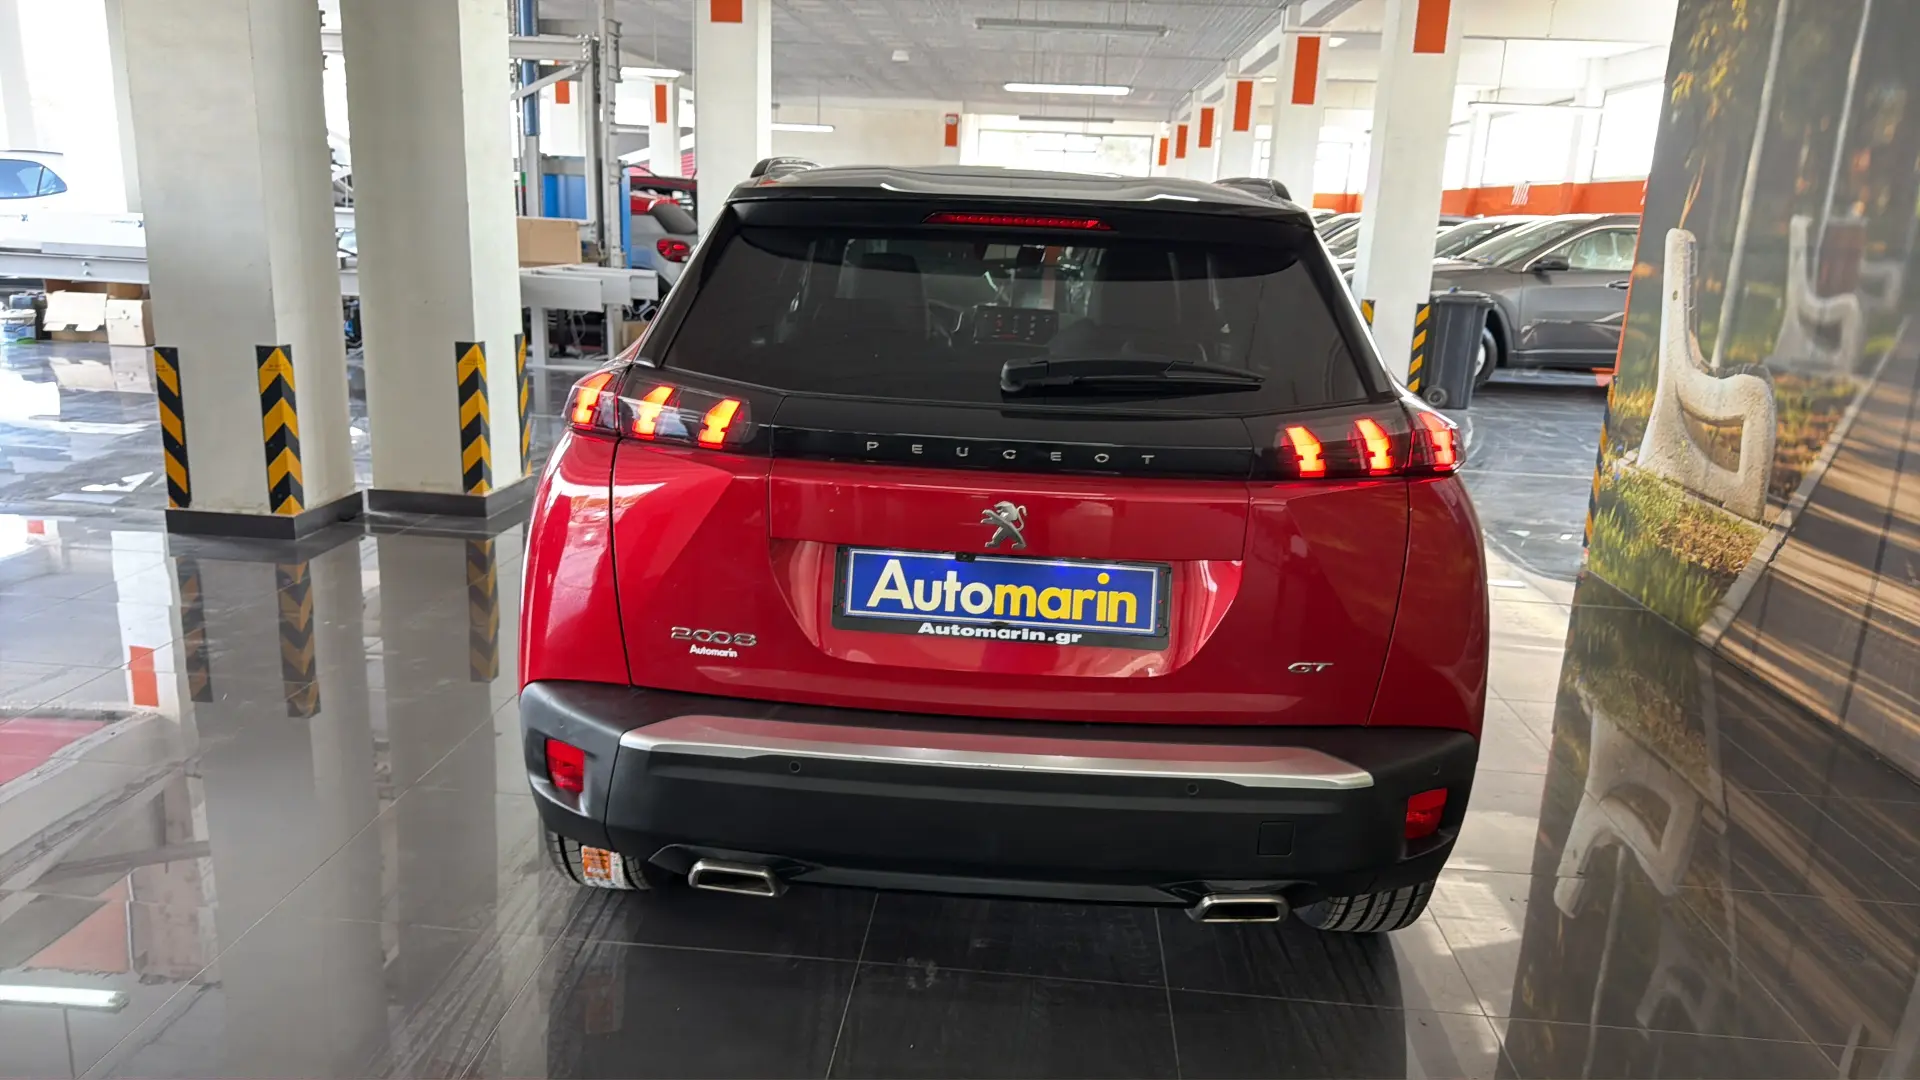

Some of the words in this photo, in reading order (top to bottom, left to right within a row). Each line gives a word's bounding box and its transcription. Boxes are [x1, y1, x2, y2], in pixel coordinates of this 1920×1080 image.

[866, 441, 1155, 465] PEUGEOT
[866, 558, 1137, 624] Automarin
[671, 626, 757, 646] 2008
[917, 622, 1083, 645] Automarin.gr
[689, 644, 738, 658] Automarin
[1287, 661, 1335, 673] GT
